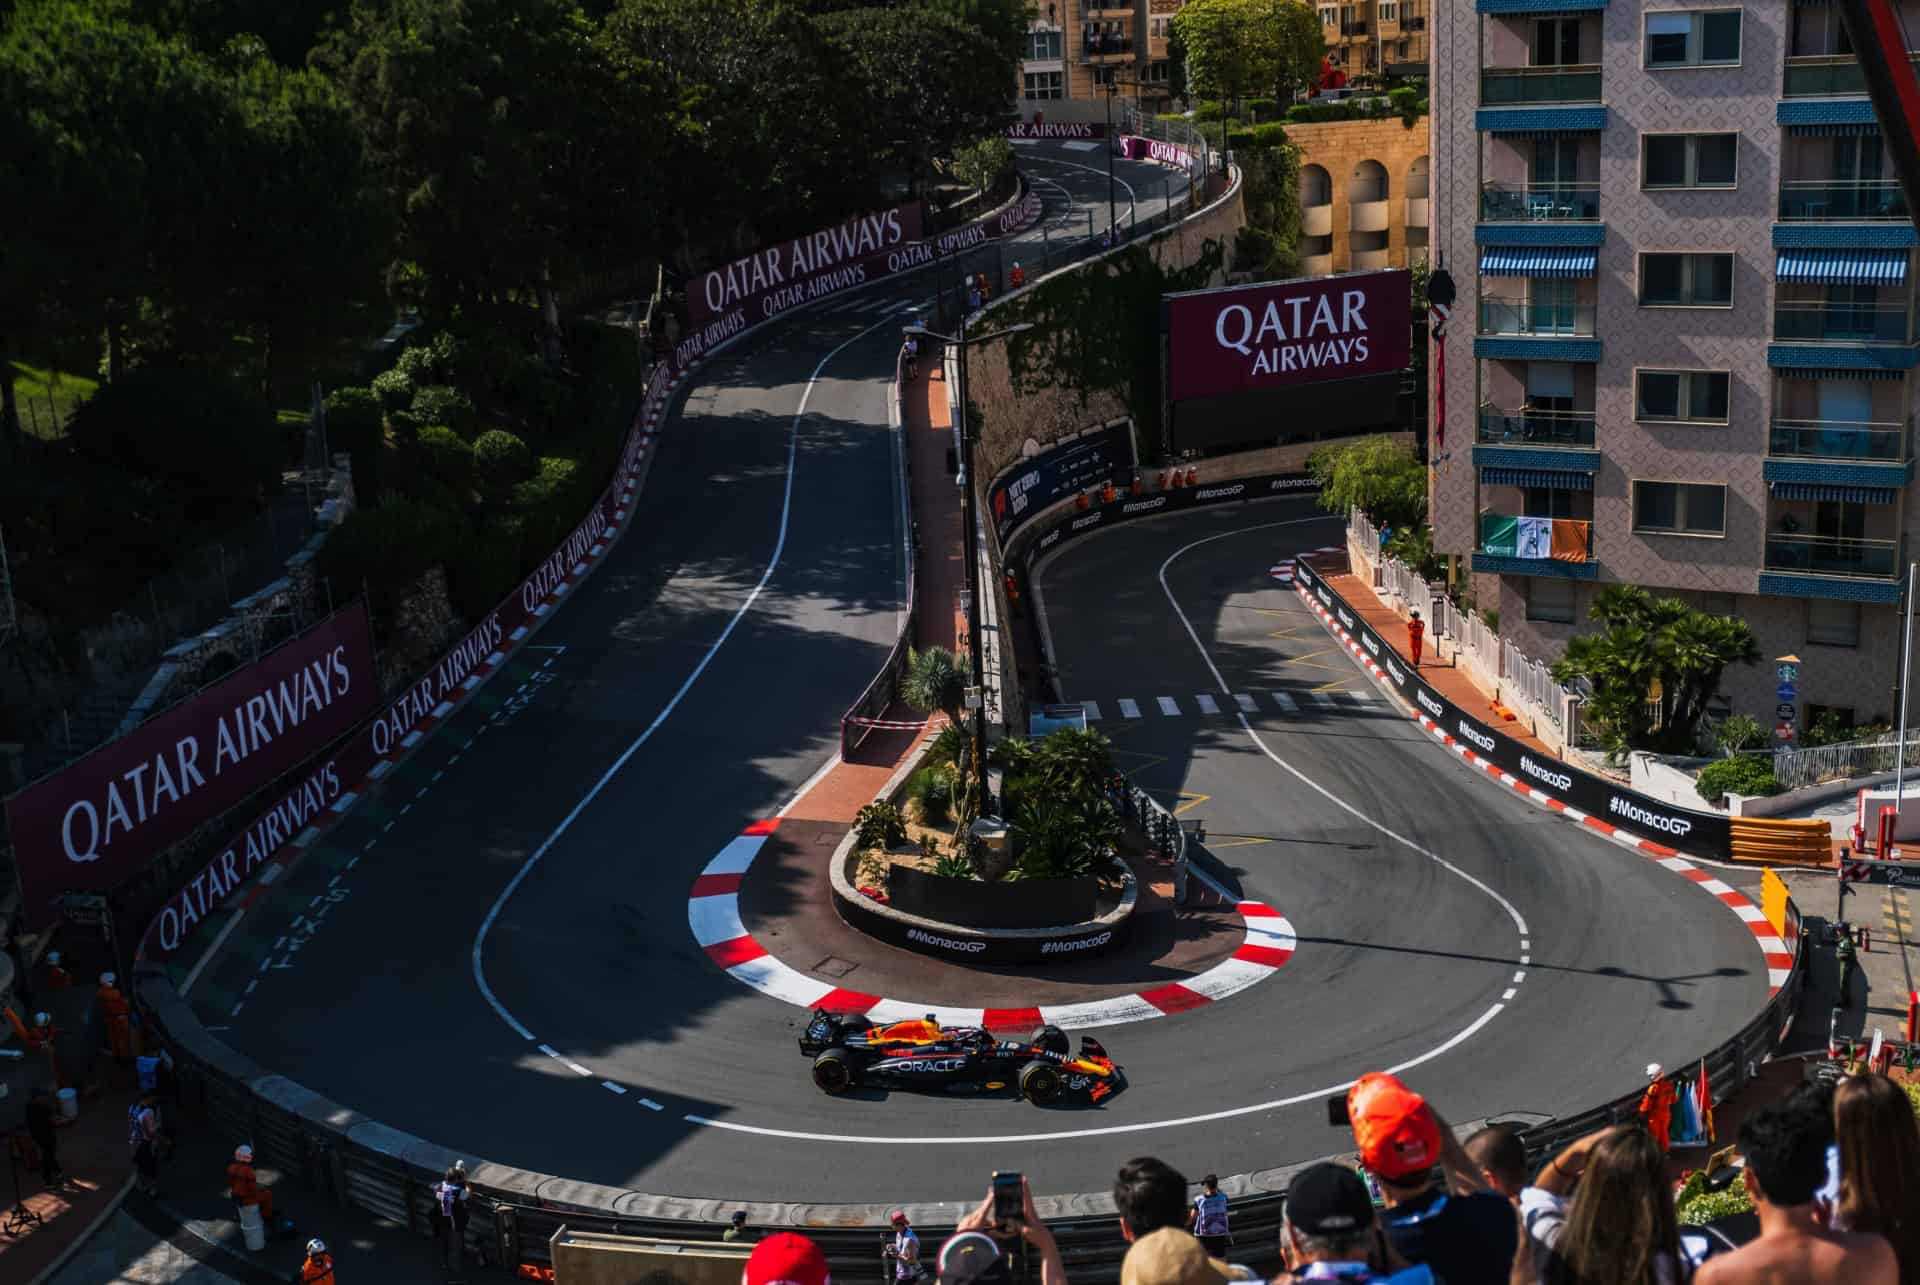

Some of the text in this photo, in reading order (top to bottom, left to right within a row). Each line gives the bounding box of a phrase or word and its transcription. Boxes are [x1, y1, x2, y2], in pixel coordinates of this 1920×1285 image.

[705, 208, 902, 312] QATAR AIRWAYS
[888, 246, 933, 272] QATAR
[762, 263, 865, 317] QATAR AIRWAYS
[1215, 290, 1369, 356] QATAR
[1250, 335, 1369, 376] AIRWAYS
[522, 551, 567, 613] QATAR
[370, 612, 503, 756] QATAR AIRWAYS
[61, 644, 351, 863] QATAR AIRWAYS
[1519, 755, 1573, 792] #MonacoGP
[1609, 795, 1692, 837] #MonacoGP
[159, 760, 341, 952] QATAR AIRWAYS
[905, 927, 987, 955] #MonacoGP
[1040, 930, 1113, 955] #MonacoGP
[898, 1060, 967, 1073] ORACLE
